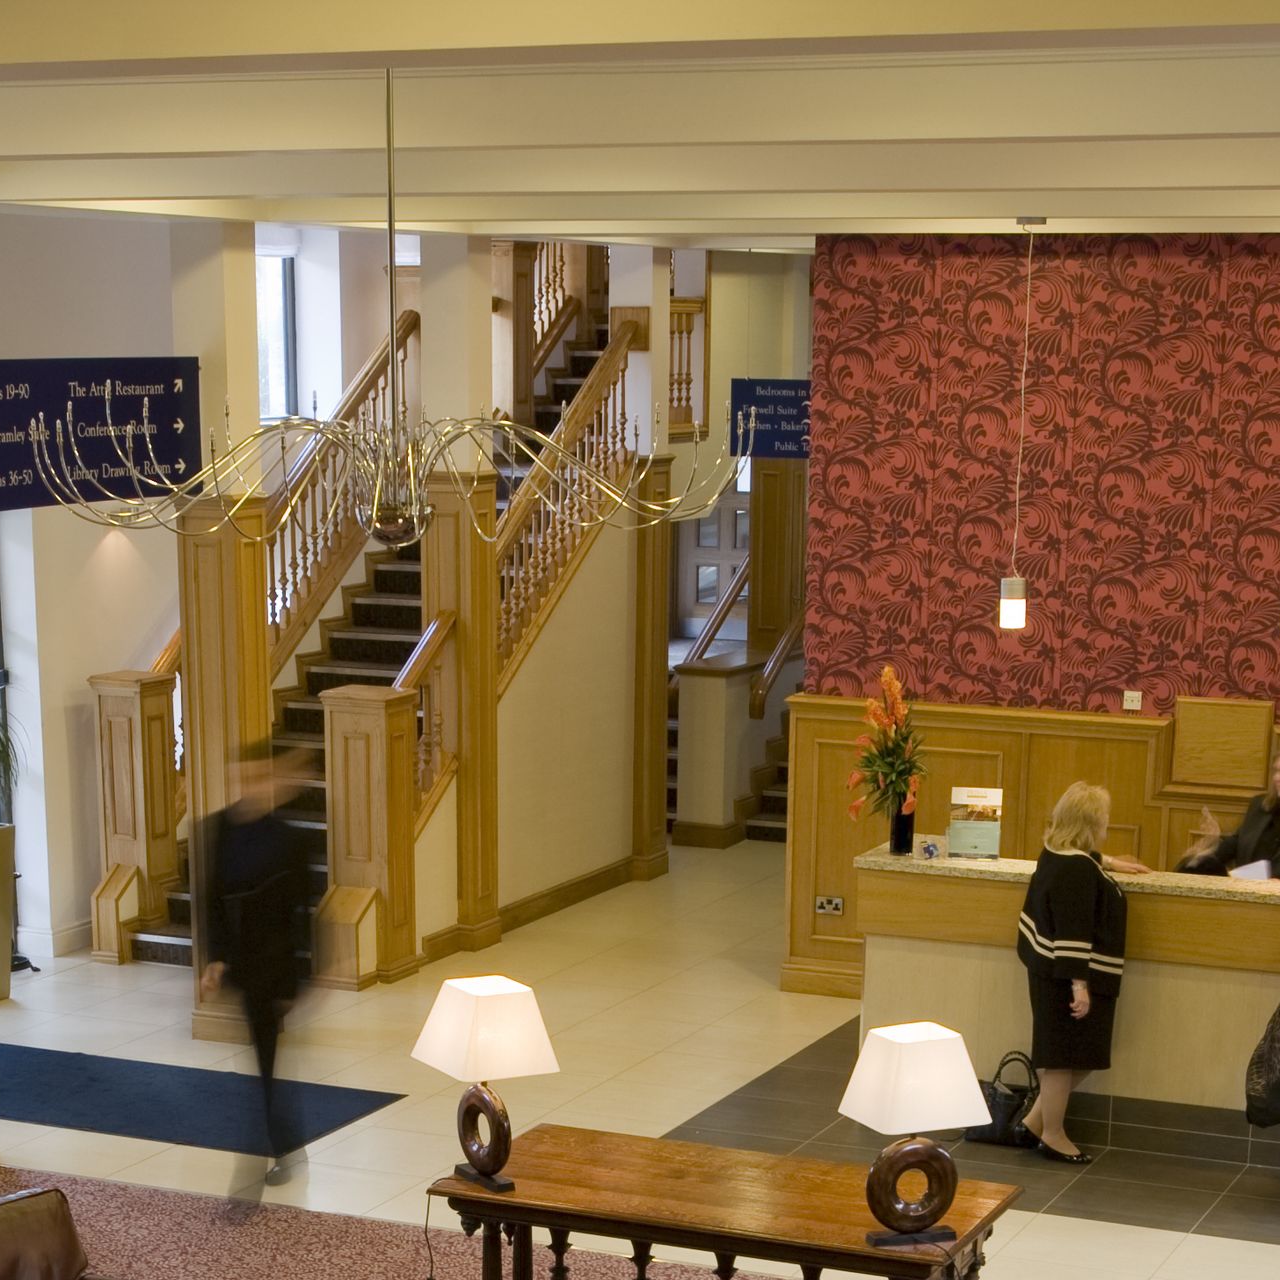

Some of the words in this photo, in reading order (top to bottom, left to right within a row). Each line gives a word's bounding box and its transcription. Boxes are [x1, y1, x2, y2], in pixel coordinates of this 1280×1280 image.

[5, 383, 30, 400] 19-90
[68, 381, 86, 397] The
[89, 381, 111, 397] Att
[115, 380, 165, 396] Restaurant
[755, 385, 795, 397] Bedrooms
[798, 387, 807, 397] in
[776, 405, 798, 416] Suite
[28, 425, 50, 442] Sue
[780, 421, 809, 432] Bakery
[774, 441, 799, 452] Public
[8, 469, 33, 487] 36-50
